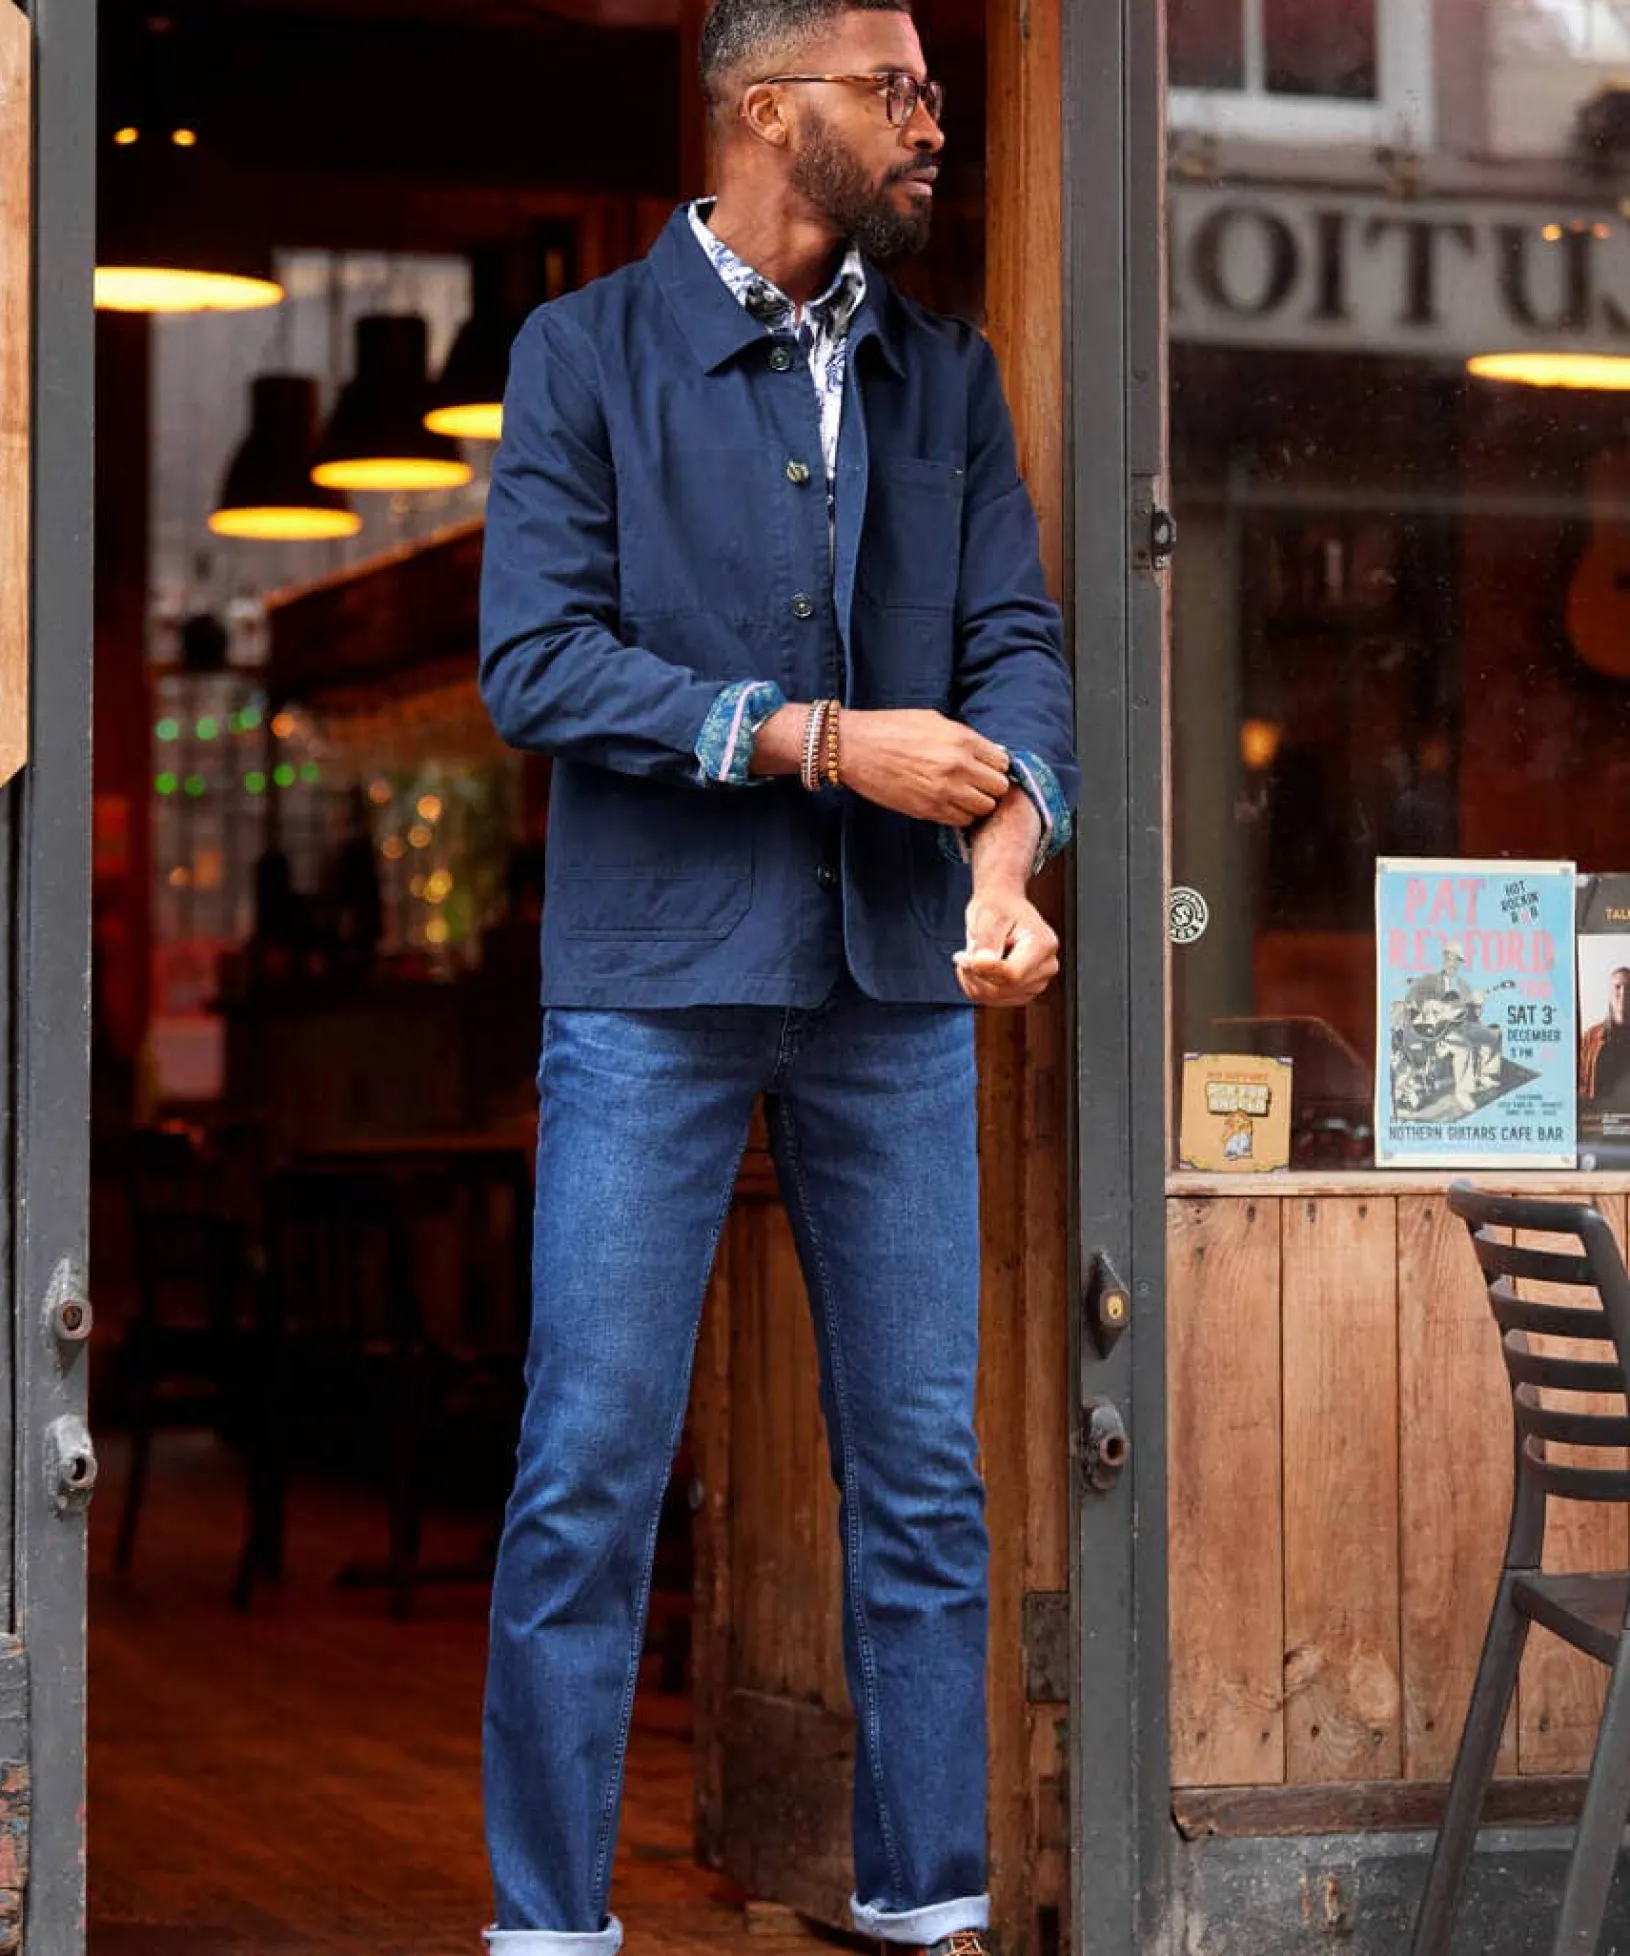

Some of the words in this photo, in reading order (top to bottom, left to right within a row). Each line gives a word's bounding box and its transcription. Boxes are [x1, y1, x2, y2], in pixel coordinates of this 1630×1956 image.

[1404, 877, 1488, 926] PAT
[1507, 1004, 1537, 1025] SAT
[1507, 1029, 1562, 1042] DECEMBER
[1447, 1126, 1496, 1142] GUITARS
[1501, 1126, 1533, 1142] CAFE
[1538, 1126, 1564, 1142] BAR
